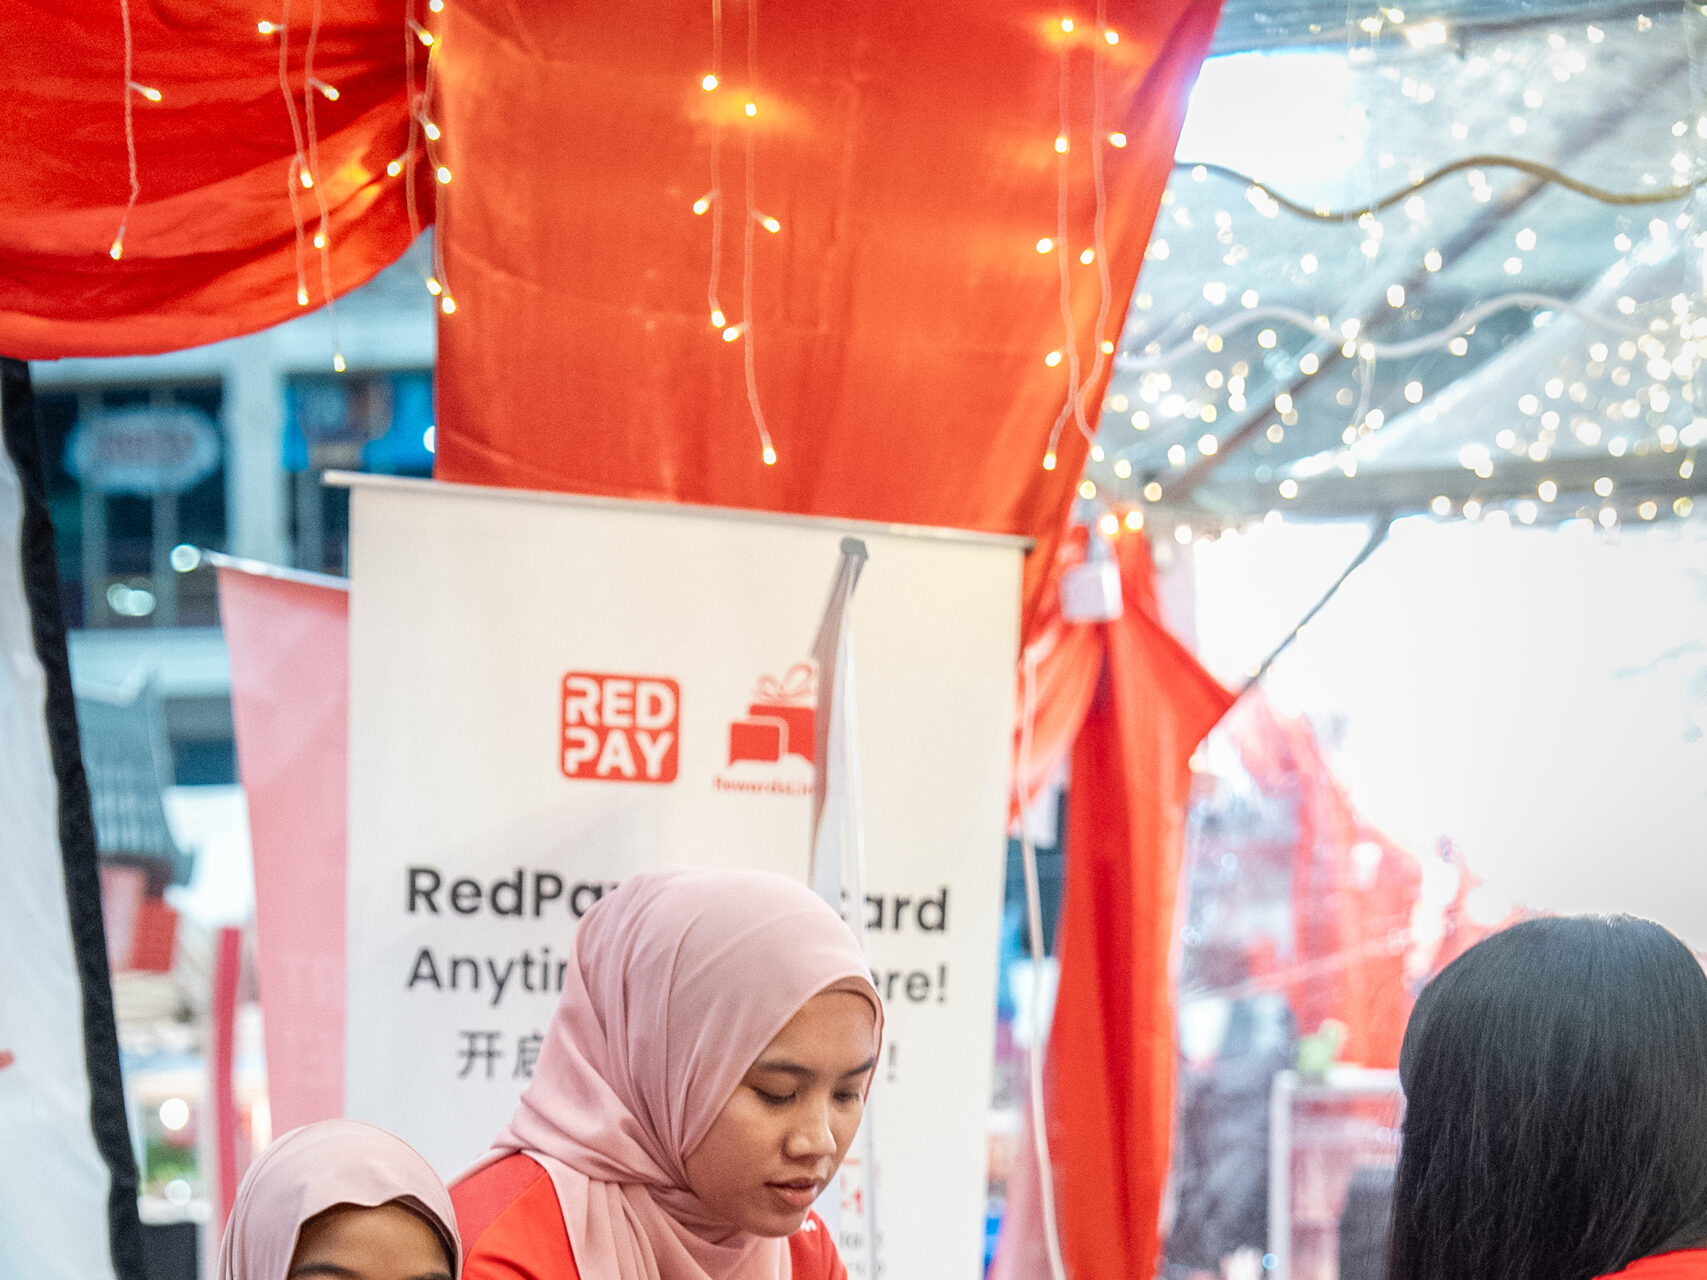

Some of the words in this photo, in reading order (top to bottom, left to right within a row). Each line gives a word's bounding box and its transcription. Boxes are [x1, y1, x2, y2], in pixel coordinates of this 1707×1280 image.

[565, 676, 676, 729] RED
[563, 726, 675, 779] PAY
[407, 865, 618, 918] RedPa
